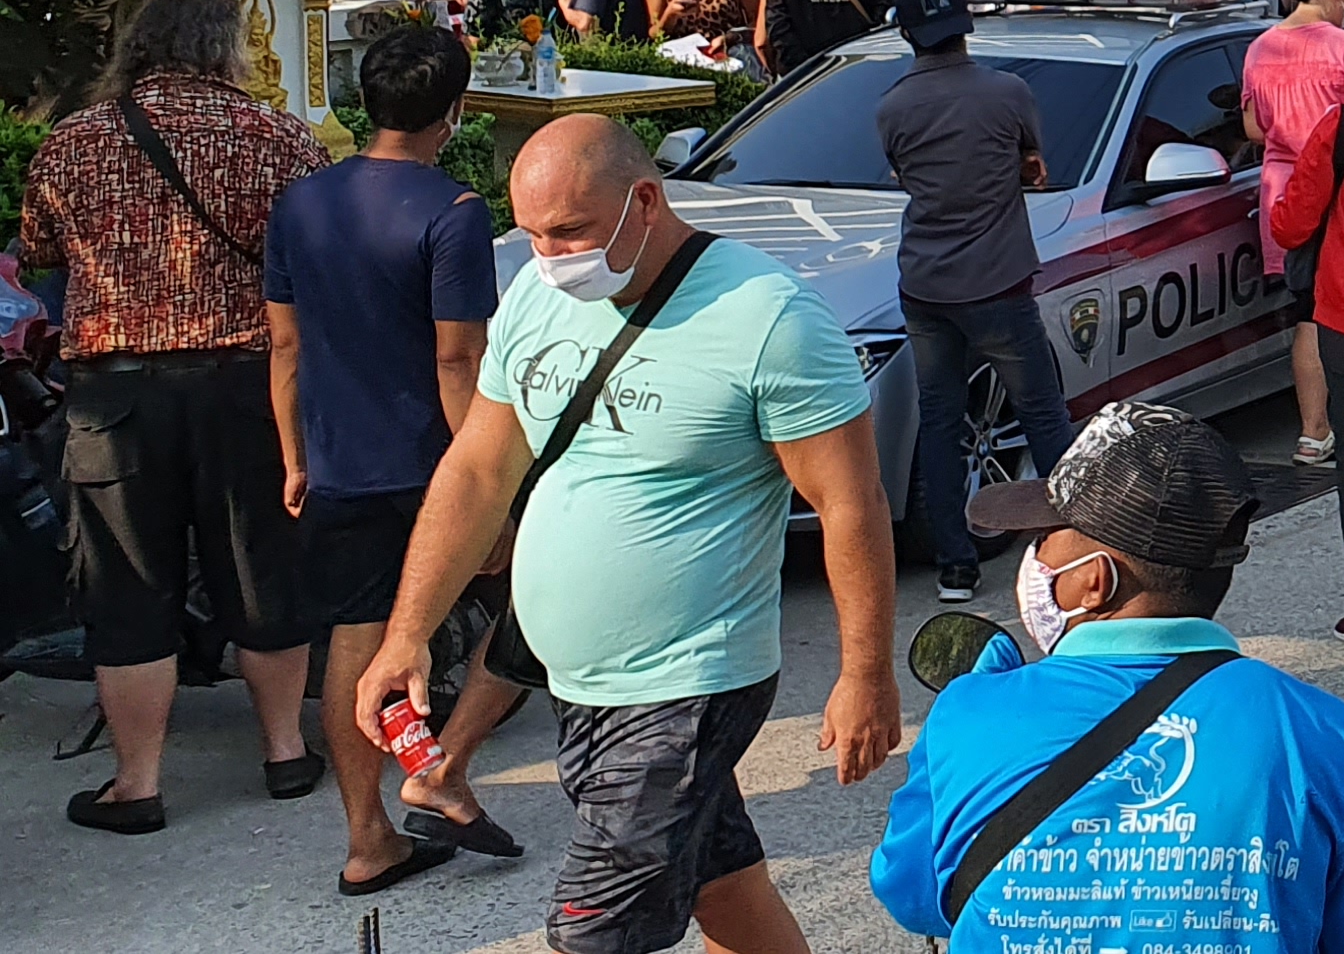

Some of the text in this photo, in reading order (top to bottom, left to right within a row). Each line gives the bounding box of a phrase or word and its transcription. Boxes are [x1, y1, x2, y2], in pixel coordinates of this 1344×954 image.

[1002, 877, 1129, 901] ข้าวหอมมะลิแท้
[988, 907, 1122, 935] รับประกันคุณภาพ
